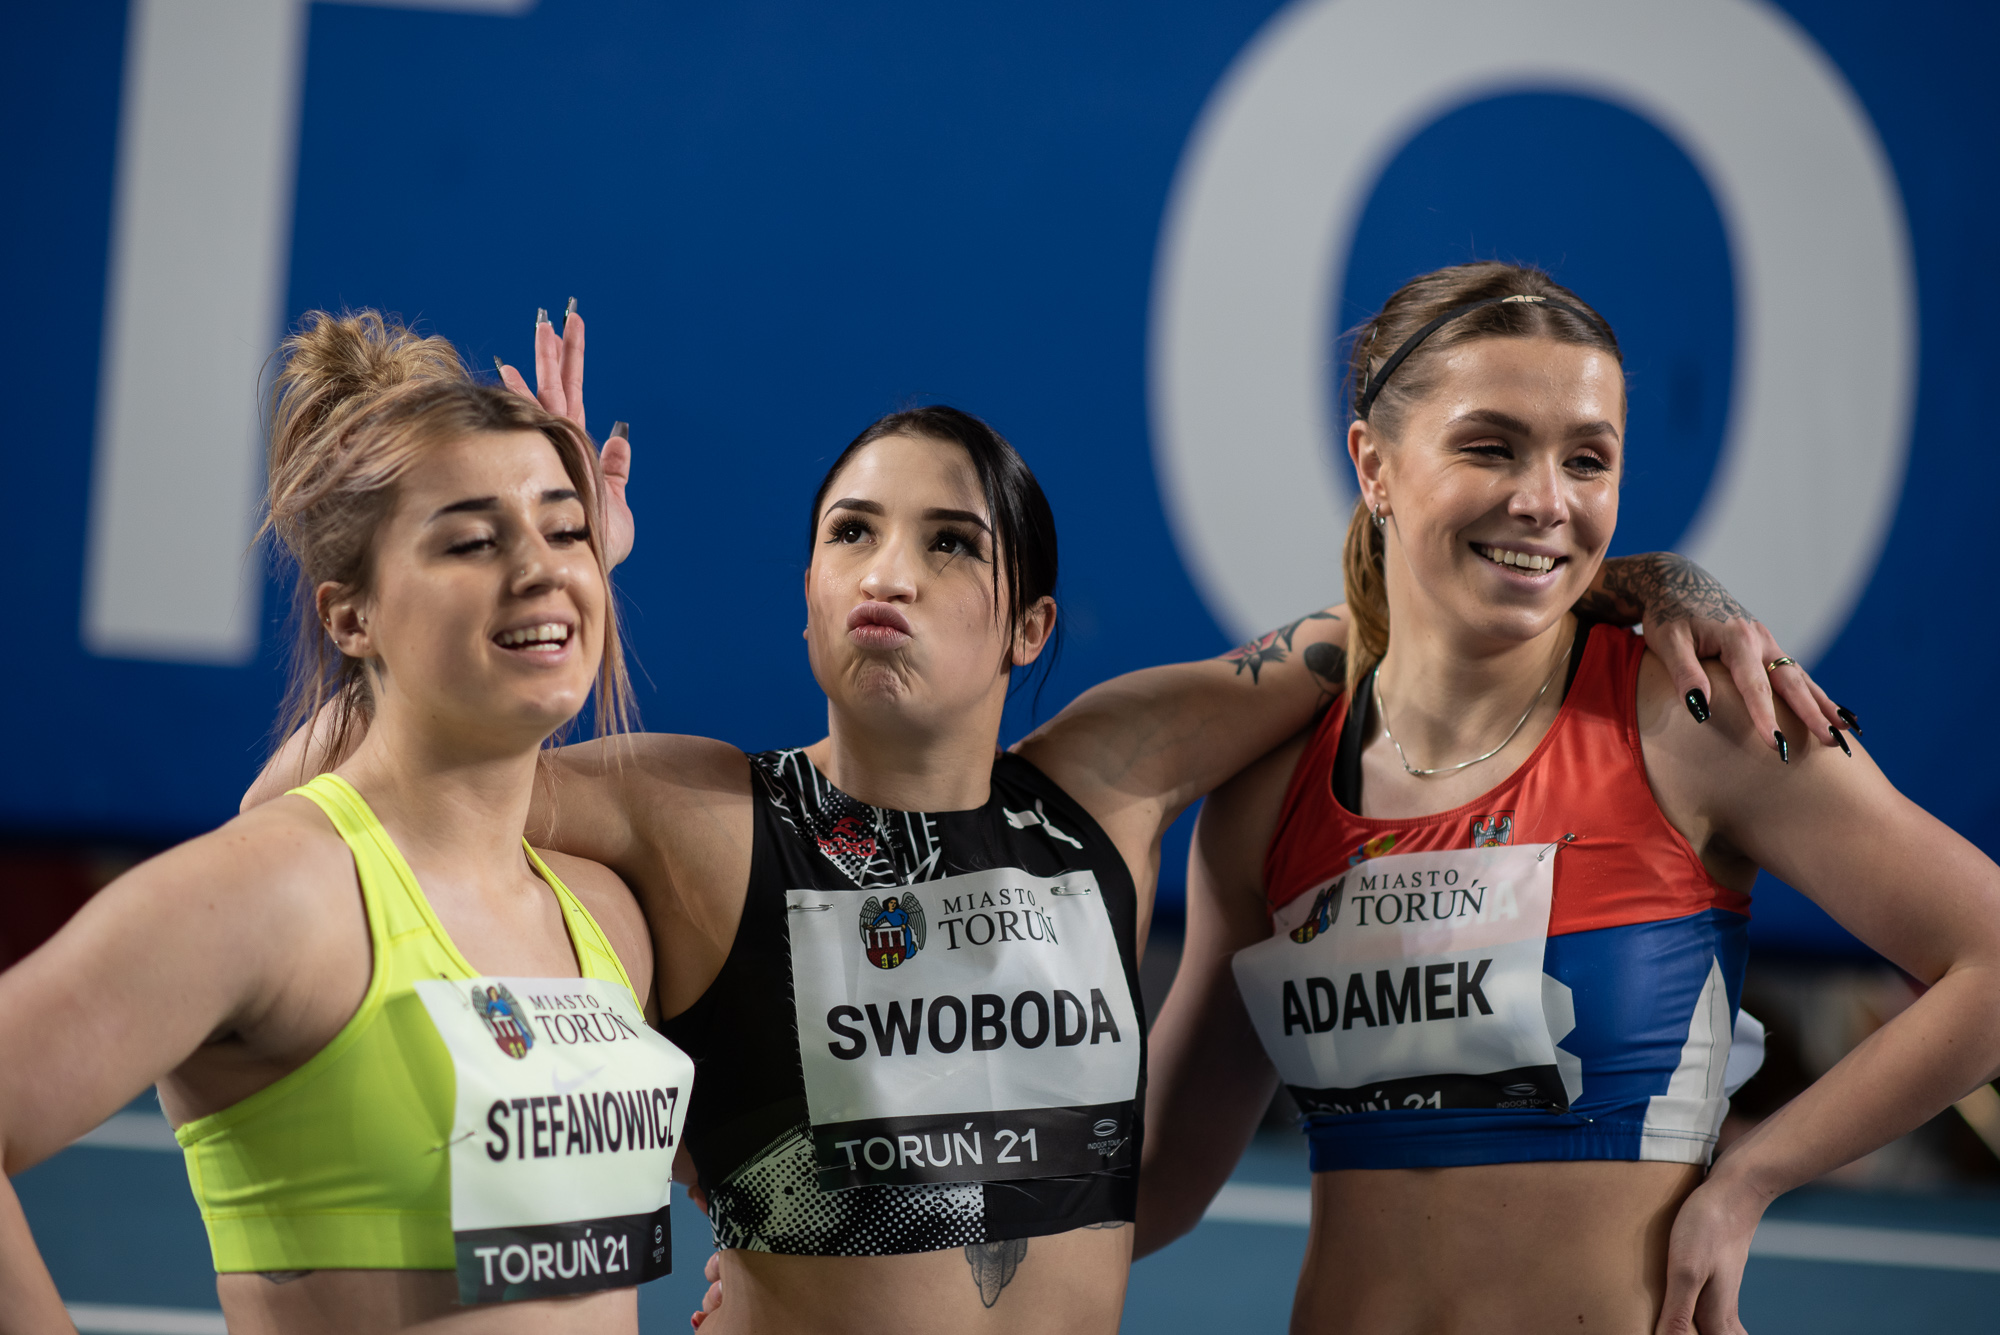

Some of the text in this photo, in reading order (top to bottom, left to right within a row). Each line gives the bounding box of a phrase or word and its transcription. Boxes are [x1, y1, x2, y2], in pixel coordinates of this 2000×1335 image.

[942, 888, 1037, 914] MIASTO
[1352, 879, 1487, 926] TORUŃ
[1359, 869, 1459, 891] MIASTO
[938, 907, 1059, 950] TORUŃ
[528, 994, 600, 1011] MIASTO
[1282, 958, 1494, 1036] ADAMEK
[535, 1007, 639, 1045] TORUŃ
[826, 988, 1121, 1060] SWOBODA
[486, 1087, 679, 1162] STEFANOWICZ
[835, 1122, 1038, 1171] TORUŃ 21
[474, 1228, 629, 1285] TORUŃ 21
